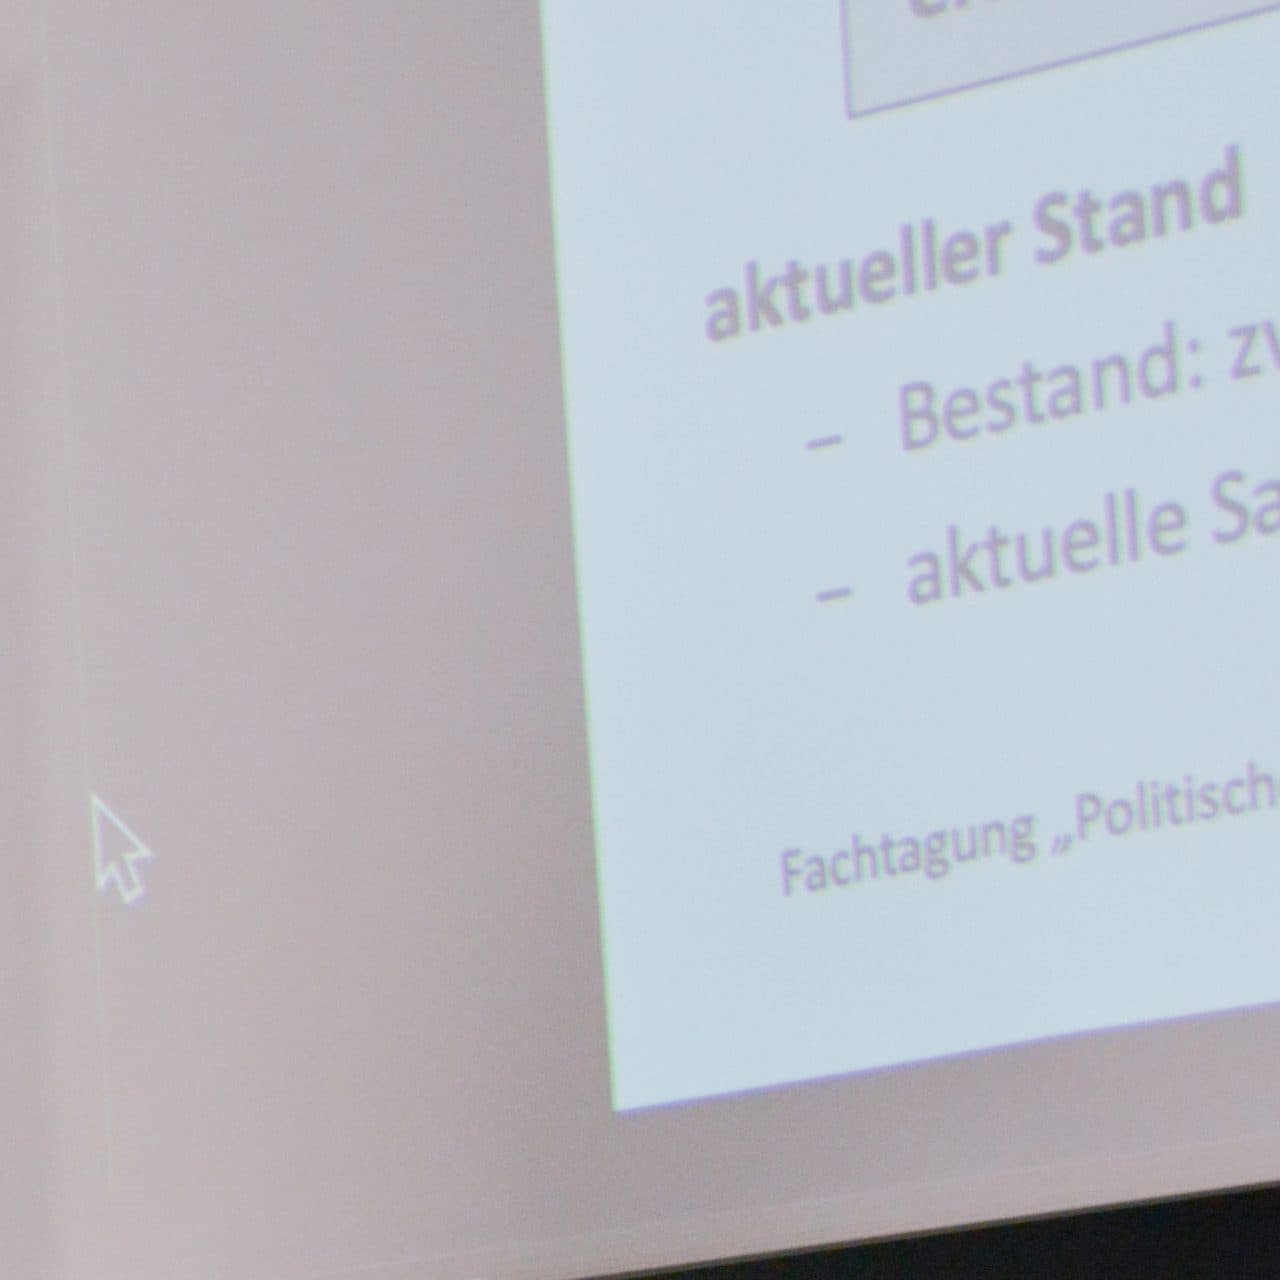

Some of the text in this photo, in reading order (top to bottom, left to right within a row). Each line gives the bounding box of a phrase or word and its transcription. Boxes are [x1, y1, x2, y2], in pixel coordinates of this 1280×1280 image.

[704, 143, 1244, 343] aktueller Stand
[899, 319, 1204, 451] Bestand:
[907, 488, 1188, 605] aktuelle
[779, 813, 1037, 897] Fachtagung
